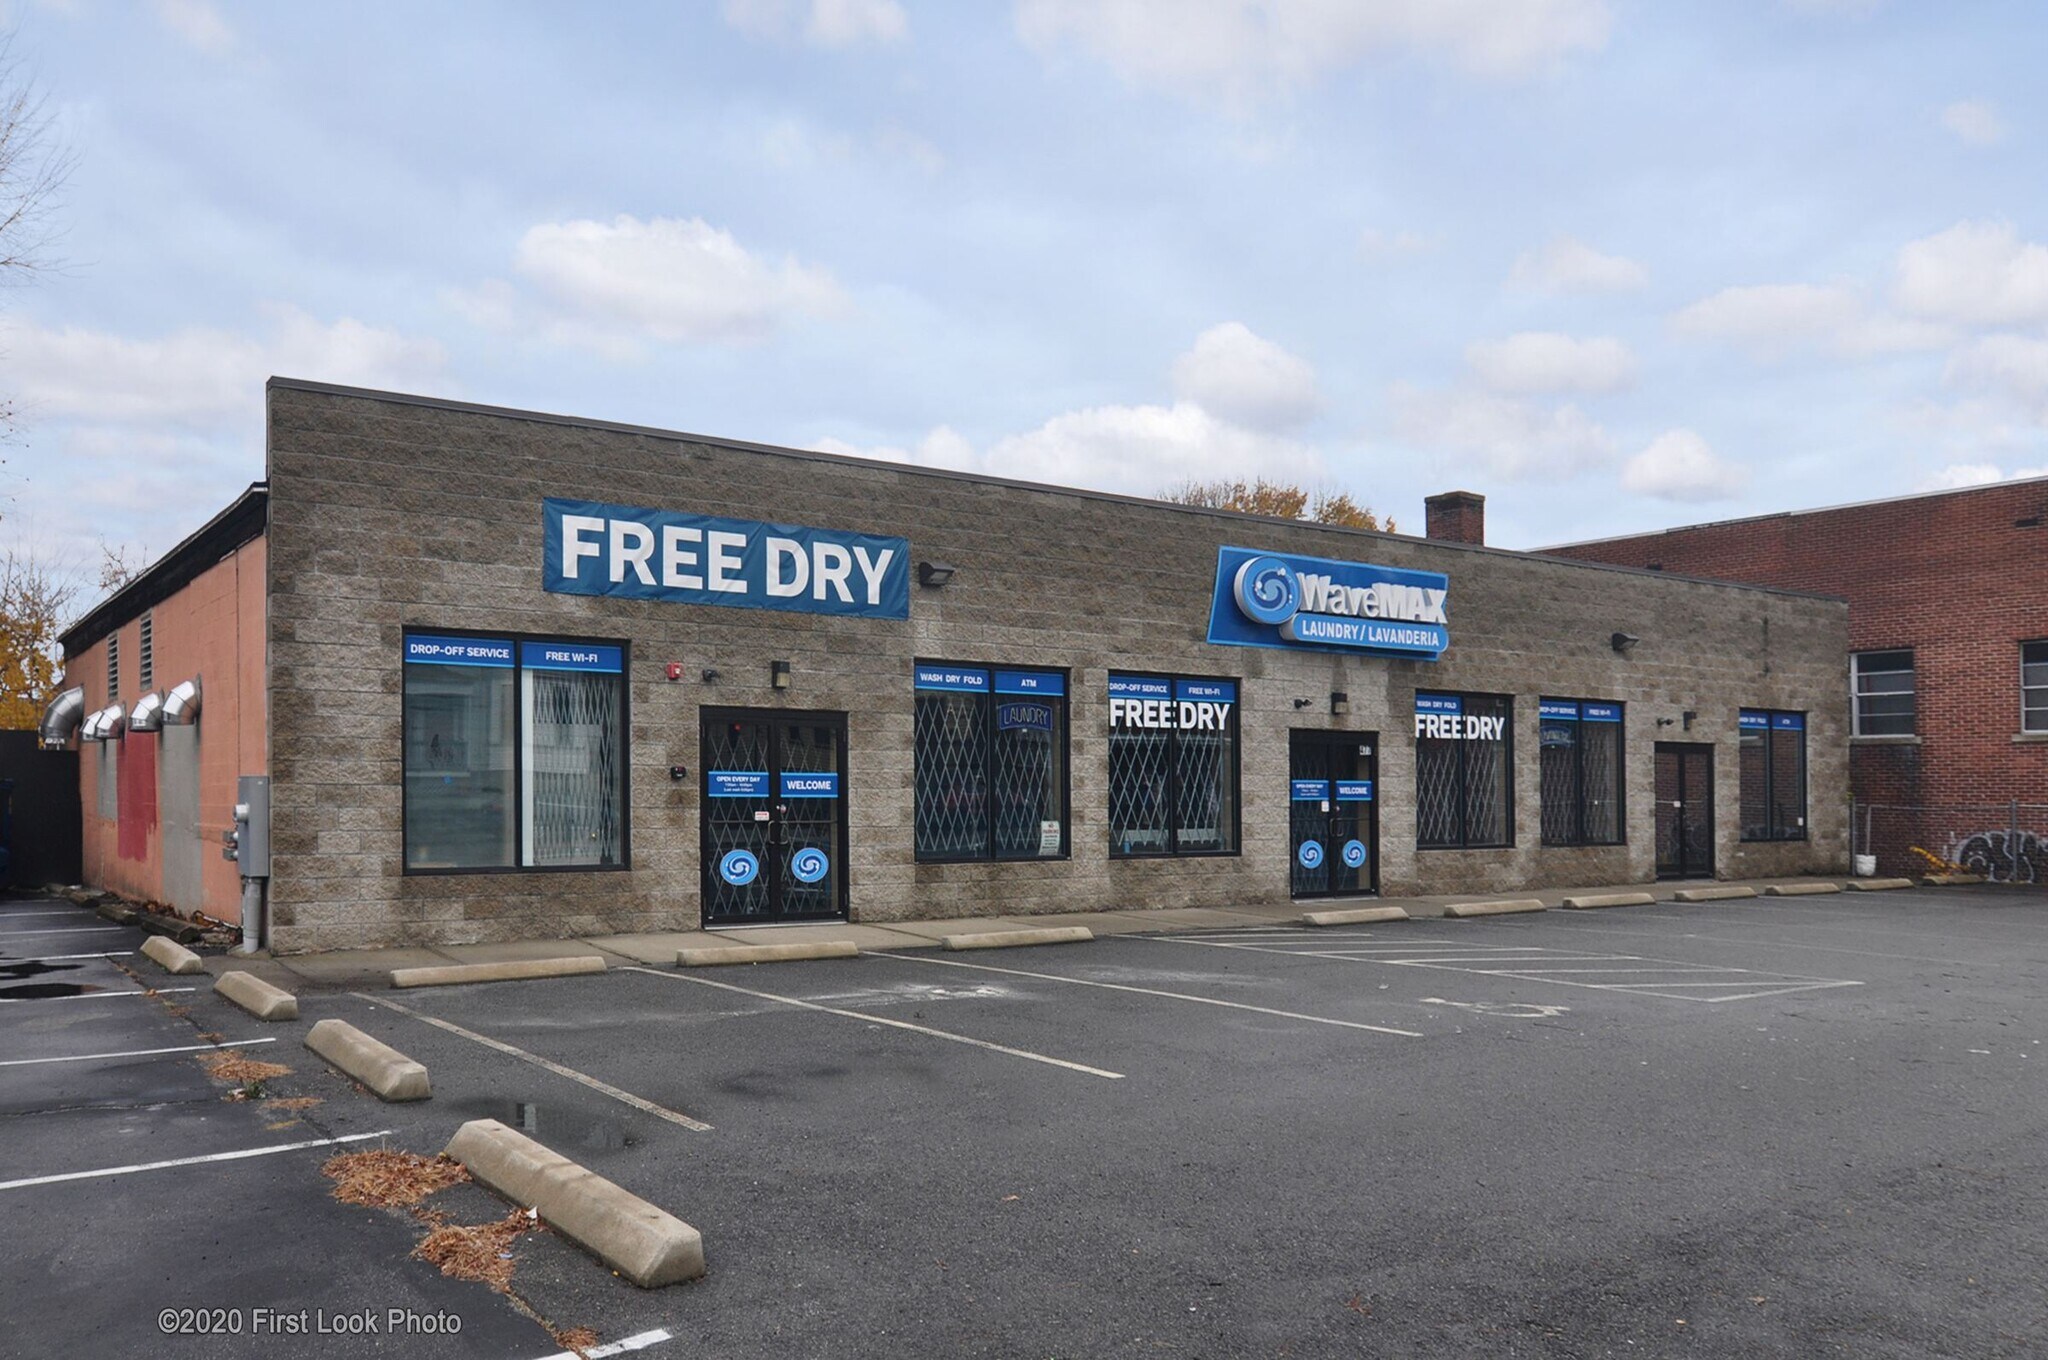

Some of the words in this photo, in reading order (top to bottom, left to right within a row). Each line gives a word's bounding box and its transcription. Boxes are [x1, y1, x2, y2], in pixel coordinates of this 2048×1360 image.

[562, 514, 747, 594] FREE
[766, 537, 894, 605] DRY
[1296, 572, 1448, 624] WaveMAX
[1302, 619, 1358, 640] LAUNDRY
[1368, 626, 1440, 646] LAVANDERIA
[410, 643, 465, 656] DROP-OFF
[466, 646, 509, 659] SERVICE
[545, 651, 571, 662] FREE
[572, 653, 598, 663] WI-FI
[920, 673, 943, 682] WASH
[945, 675, 961, 683] DRY
[963, 676, 983, 685] FOLD
[1020, 679, 1037, 688] ATM
[1109, 682, 1141, 691] DROP-OFF
[1142, 684, 1168, 693] SERVICE
[1188, 687, 1204, 695] FREE
[1003, 707, 1048, 725] LAUNDRY
[1110, 698, 1177, 728] FREE
[1180, 701, 1230, 730] DRY
[1415, 714, 1467, 739] FREE
[1467, 715, 1505, 740] DRY
[786, 780, 832, 790] WELCOME
[1339, 786, 1368, 795] WELCOME
